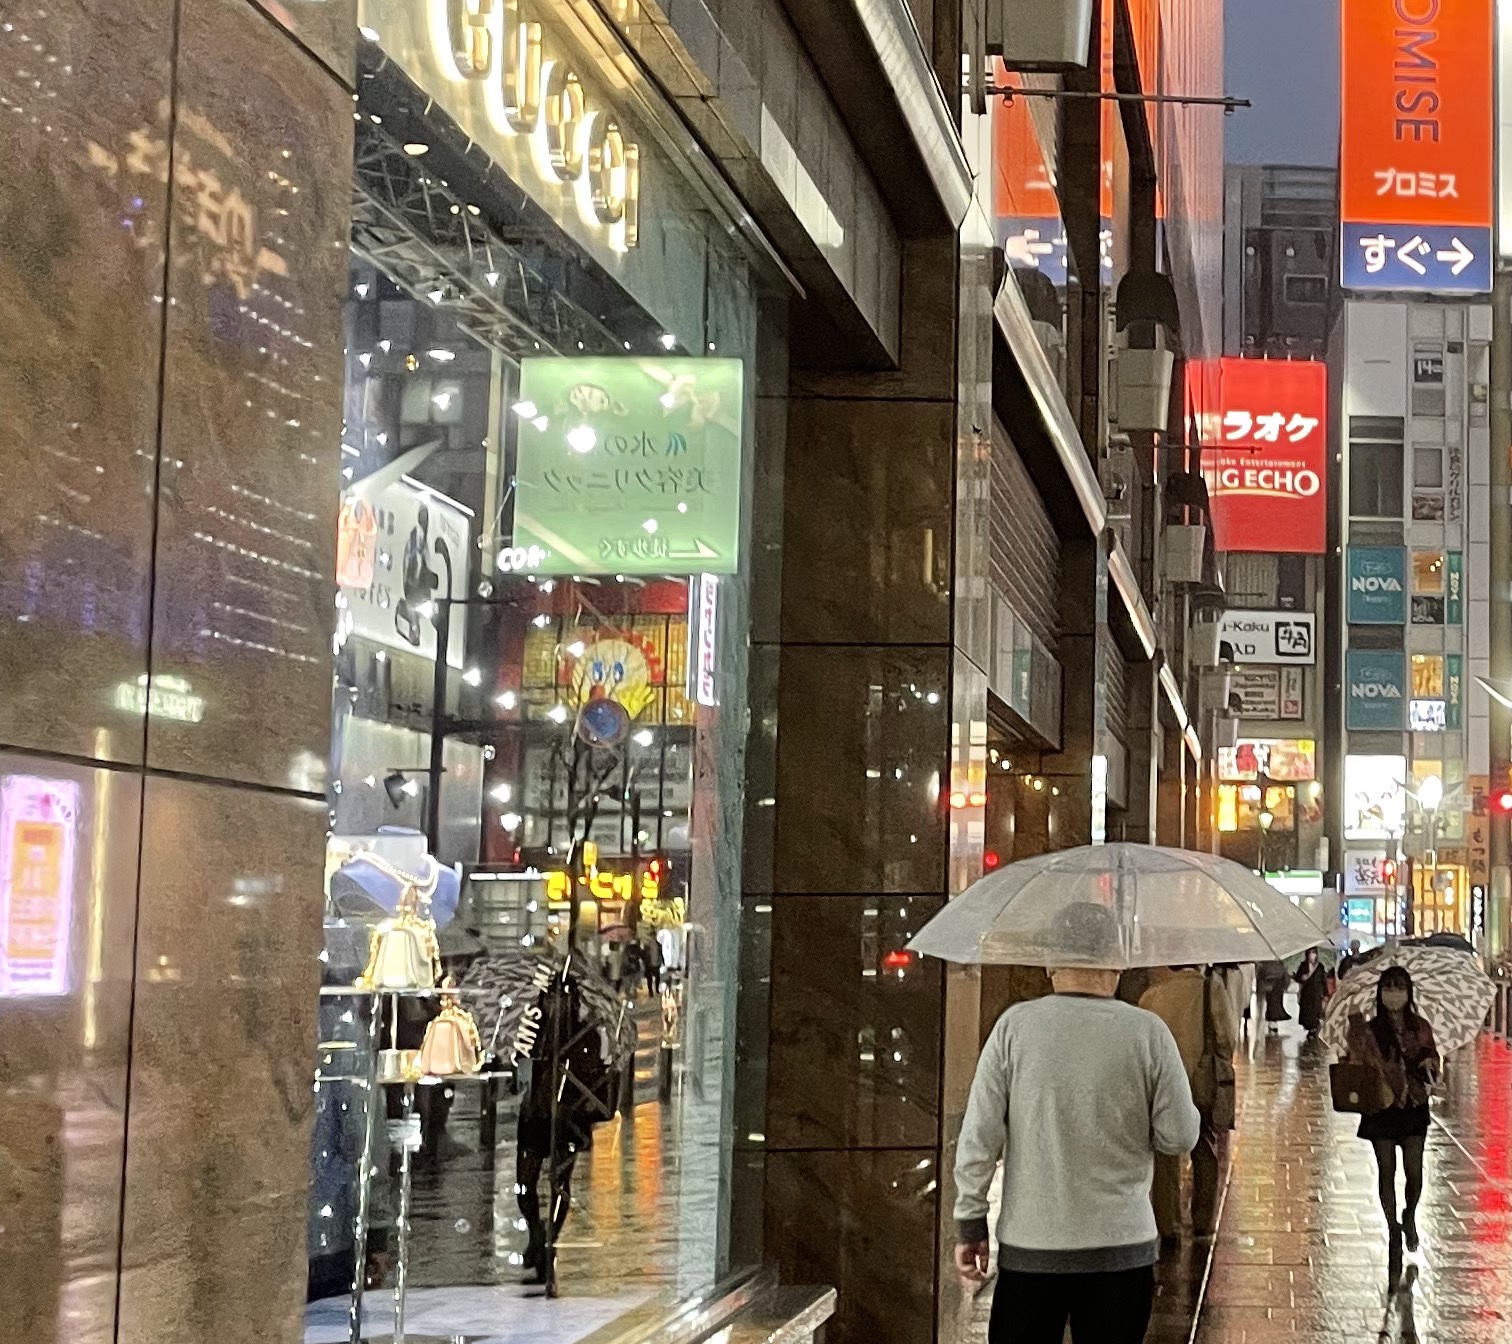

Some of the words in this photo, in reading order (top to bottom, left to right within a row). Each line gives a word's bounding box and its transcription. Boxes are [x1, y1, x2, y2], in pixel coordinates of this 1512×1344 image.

[1373, 168, 1459, 200] プロミス
[1359, 233, 1432, 275] すぐ
[1244, 469, 1320, 496] ECHO
[1352, 576, 1402, 593] NOVA
[1450, 572, 1459, 601] NOVA
[1351, 683, 1402, 699] NOVA
[1450, 676, 1459, 705] NOVA
